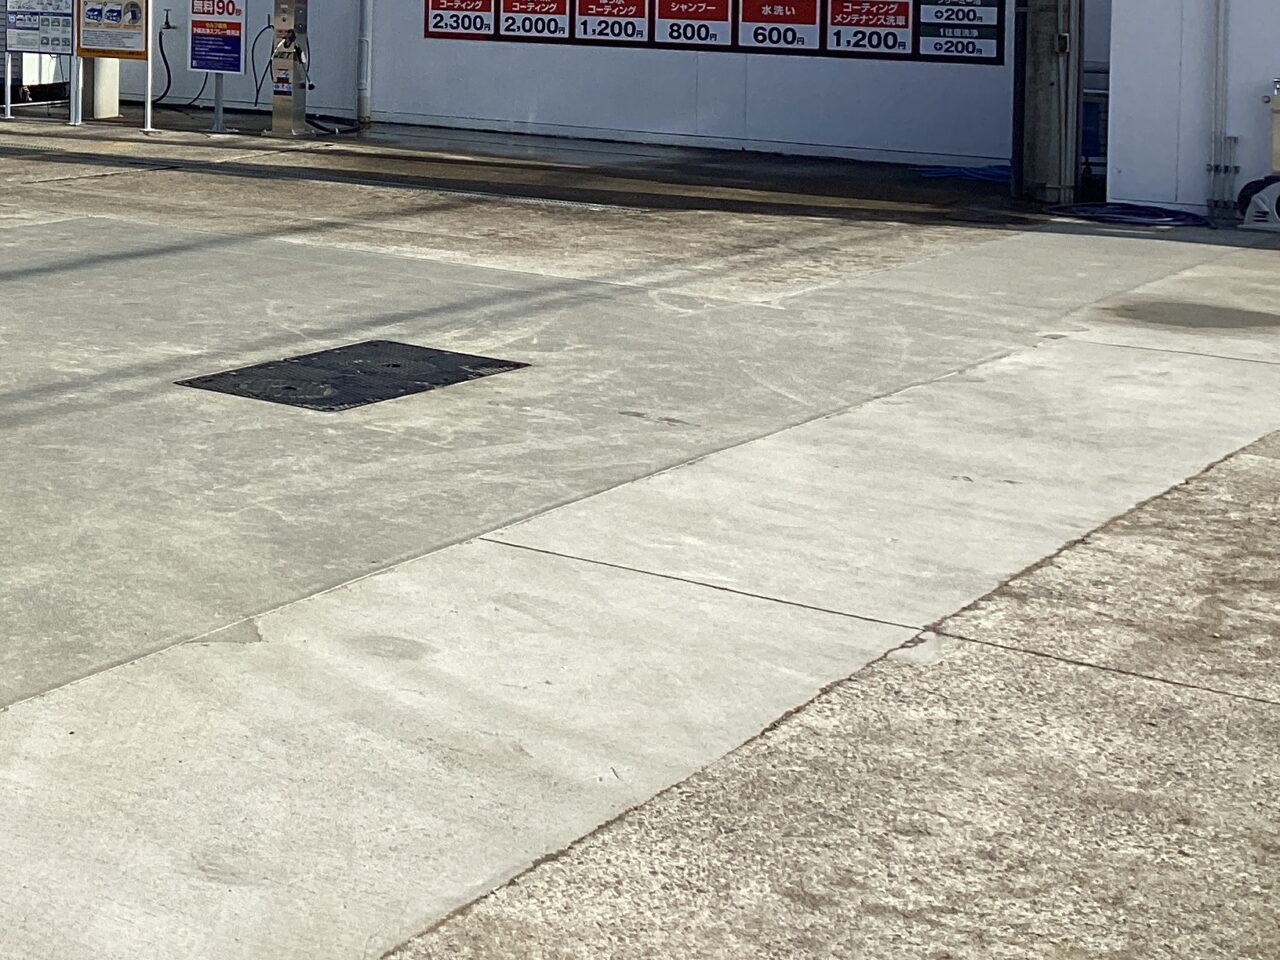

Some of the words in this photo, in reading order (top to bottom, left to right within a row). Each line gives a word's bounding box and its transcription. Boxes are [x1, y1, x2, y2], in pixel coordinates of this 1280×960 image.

[193, 0, 213, 14] 無料
[440, 0, 482, 9] コーティング
[512, 2, 557, 12] コーティング
[588, 5, 636, 15] コーティング
[670, 2, 717, 12] シャンプー
[761, 5, 796, 16] 水洗い
[843, 2, 898, 14] コーティング
[433, 13, 490, 31] 2,300円
[504, 16, 565, 34] 2,000円
[834, 14, 906, 26] メンテナンス洗車
[580, 20, 643, 38] 1,200円
[669, 23, 718, 41] 800円
[753, 26, 805, 45] 600円
[833, 29, 907, 49] 1,200円
